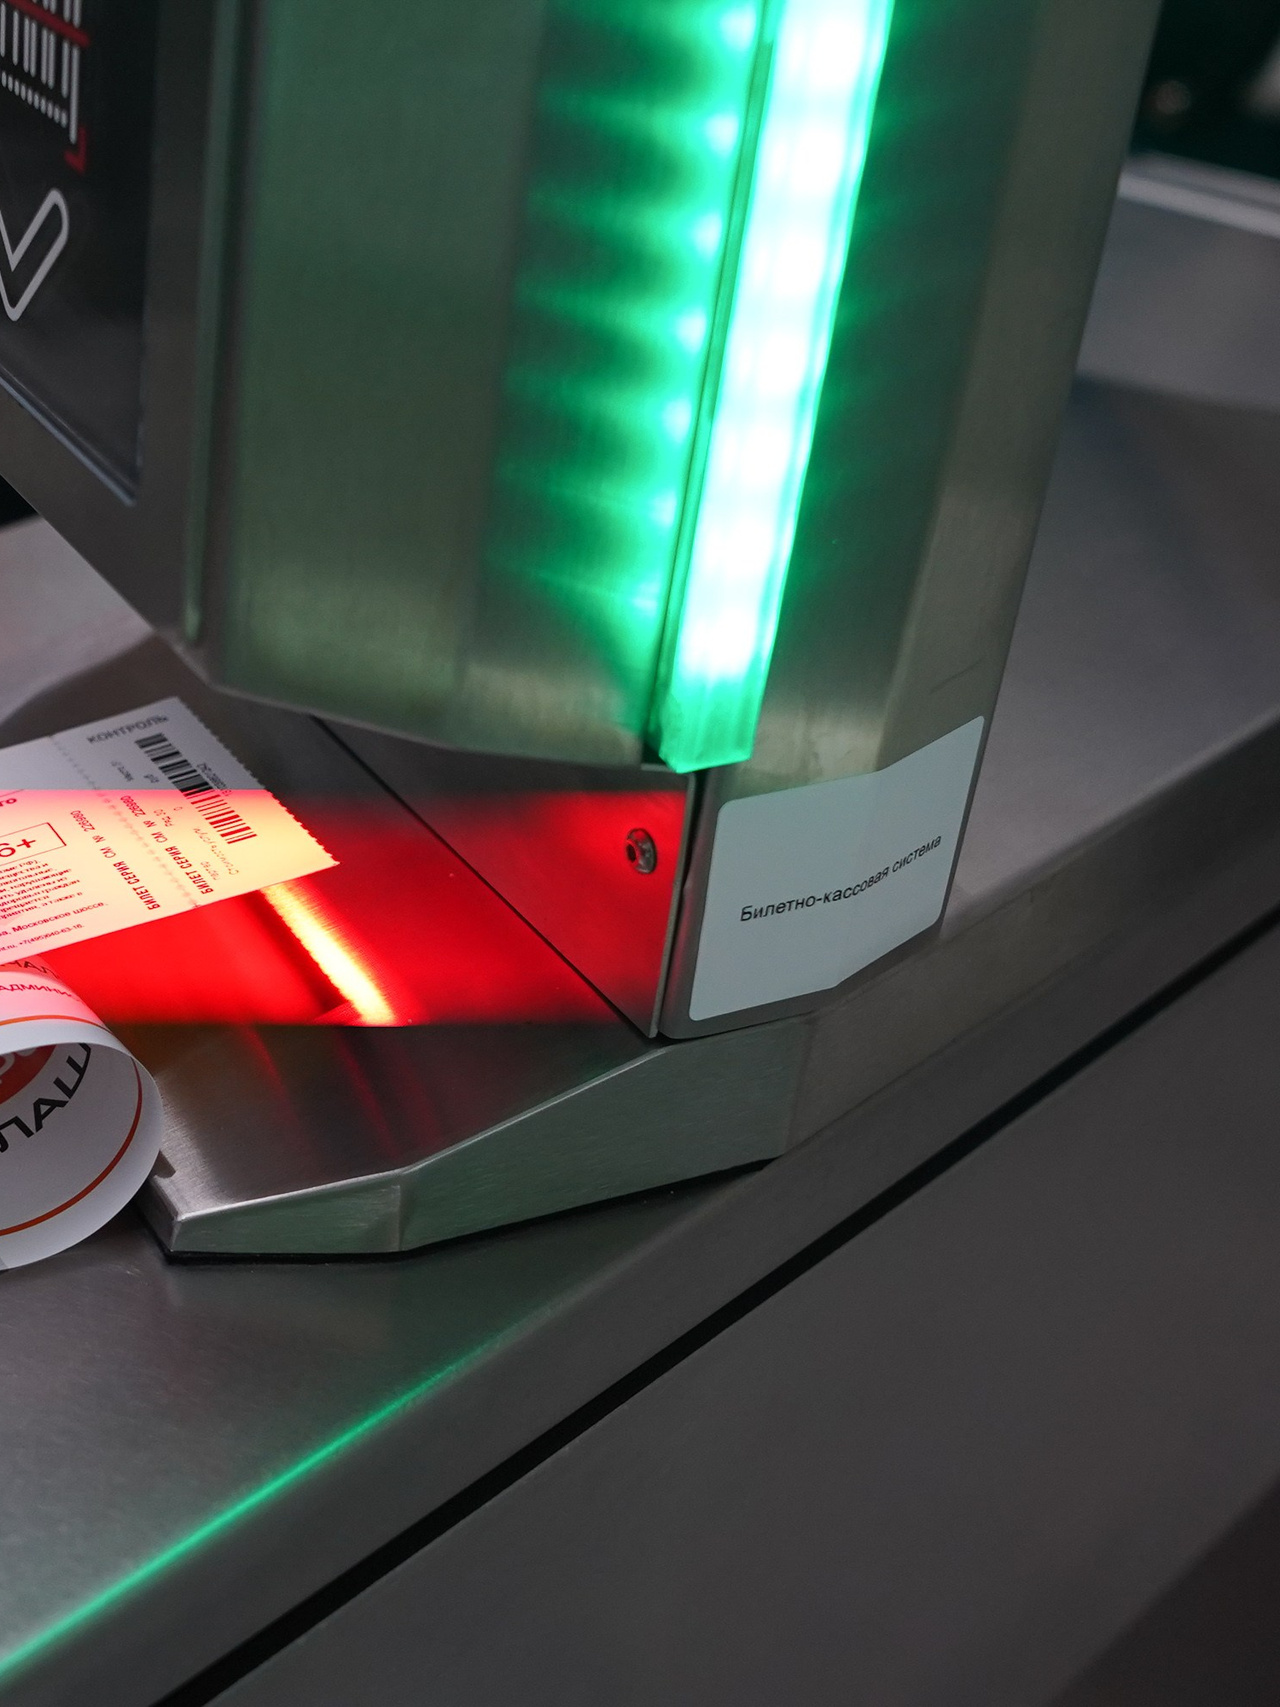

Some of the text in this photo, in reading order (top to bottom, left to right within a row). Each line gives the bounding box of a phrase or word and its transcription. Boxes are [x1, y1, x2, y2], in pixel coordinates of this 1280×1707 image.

[86, 715, 169, 744] КОНТРОЛЬ
[120, 795, 146, 817] 226980
[151, 831, 167, 843] СМ
[70, 810, 160, 910] БИЛЕТ СЕРИЯ СМ № 226980
[164, 845, 192, 869] СЕРИЯ
[185, 870, 213, 894] БИЛЕТ
[740, 833, 943, 923] Билетно-кассовая система
[11, 912, 71, 932] Московское
